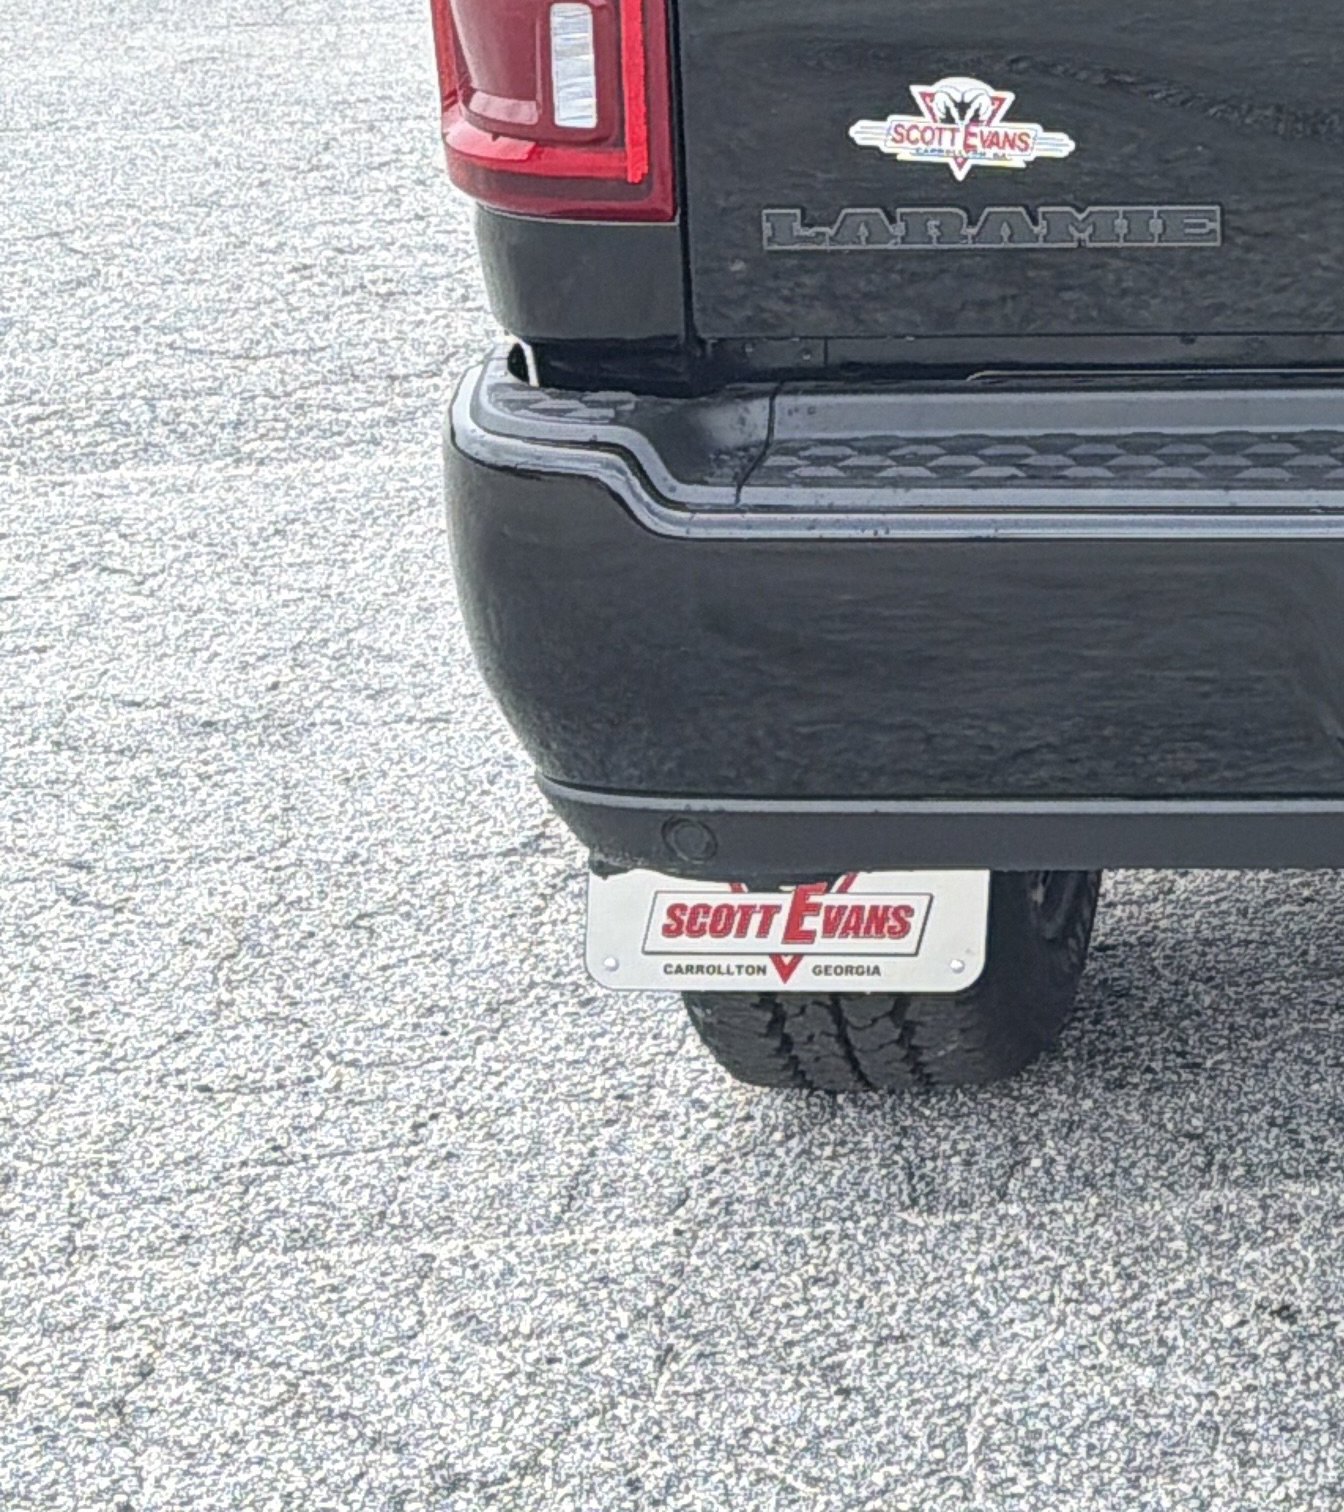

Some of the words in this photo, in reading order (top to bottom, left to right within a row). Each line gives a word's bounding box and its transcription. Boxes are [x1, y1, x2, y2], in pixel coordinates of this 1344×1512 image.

[891, 123, 960, 146] SCOTT
[962, 119, 1032, 152] EVANS
[761, 205, 1222, 251] LARAMIE
[661, 902, 781, 939] SCOTT
[780, 882, 916, 945] EVANS
[663, 962, 768, 977] CARROLLTON
[811, 964, 882, 977] GEORGIA
